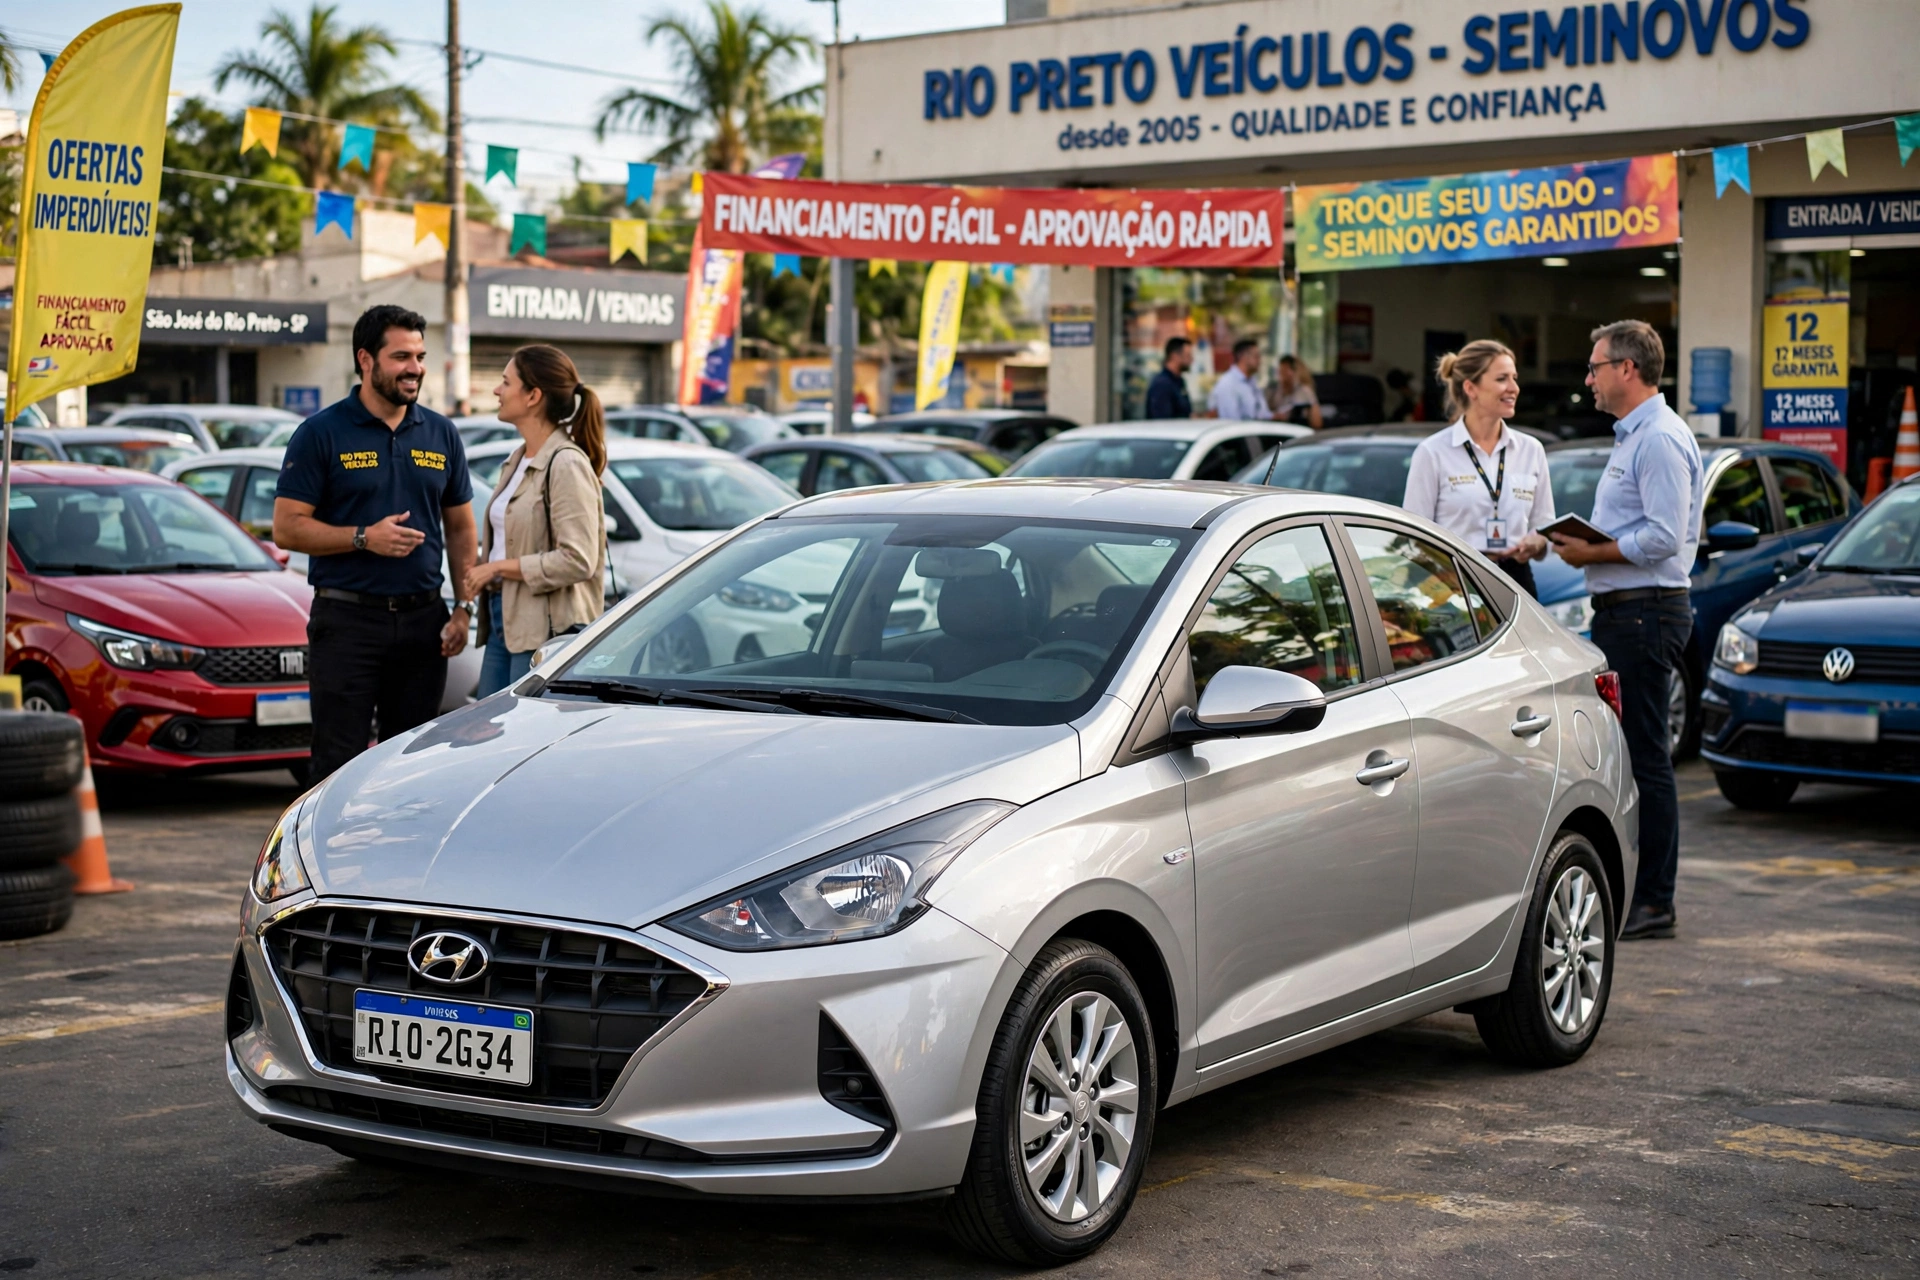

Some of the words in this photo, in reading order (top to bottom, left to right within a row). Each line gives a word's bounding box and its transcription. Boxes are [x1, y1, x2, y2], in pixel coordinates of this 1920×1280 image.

[923, 65, 996, 121] RIO
[1009, 49, 1157, 113] PRETO
[1169, 23, 1416, 100] VEÍCULOS
[1461, 0, 1811, 76] SEMINOVOS
[1057, 121, 1130, 151] desde
[1138, 114, 1201, 145] 2005
[1230, 99, 1390, 141] QUALIDADE
[1400, 98, 1416, 125] E
[1427, 81, 1607, 122] CONFIANÇA
[47, 138, 144, 186] OFERTAS
[34, 189, 152, 237] IMPERDÍVEIS!
[1320, 191, 1433, 226] TROQUE
[1438, 186, 1491, 218] SEU
[1499, 176, 1597, 212] USADO
[1787, 202, 1864, 228] ENTRADA
[713, 193, 926, 244] FINANCIAMENTO
[930, 196, 1000, 245] FÁCIL
[1019, 200, 1175, 258] APROVAÇÃO
[1178, 200, 1273, 249] RÁPIDA
[1323, 220, 1478, 259] SEMINOVOS
[1483, 205, 1661, 248] GARANTIDOS
[37, 294, 126, 314] FINANCIAMENTO
[146, 308, 173, 329] São
[173, 308, 203, 330] José
[204, 309, 223, 331] do
[224, 311, 246, 332] Rio
[247, 312, 281, 333] Preto
[290, 313, 309, 333] SP
[487, 283, 583, 321] ENTRADA
[597, 289, 675, 326] VENDAS
[1785, 311, 1819, 342] 12
[1772, 361, 1839, 377] GARANTIA
[1792, 345, 1834, 361] MESES
[1775, 393, 1793, 410] 12
[1795, 394, 1835, 409] MESES
